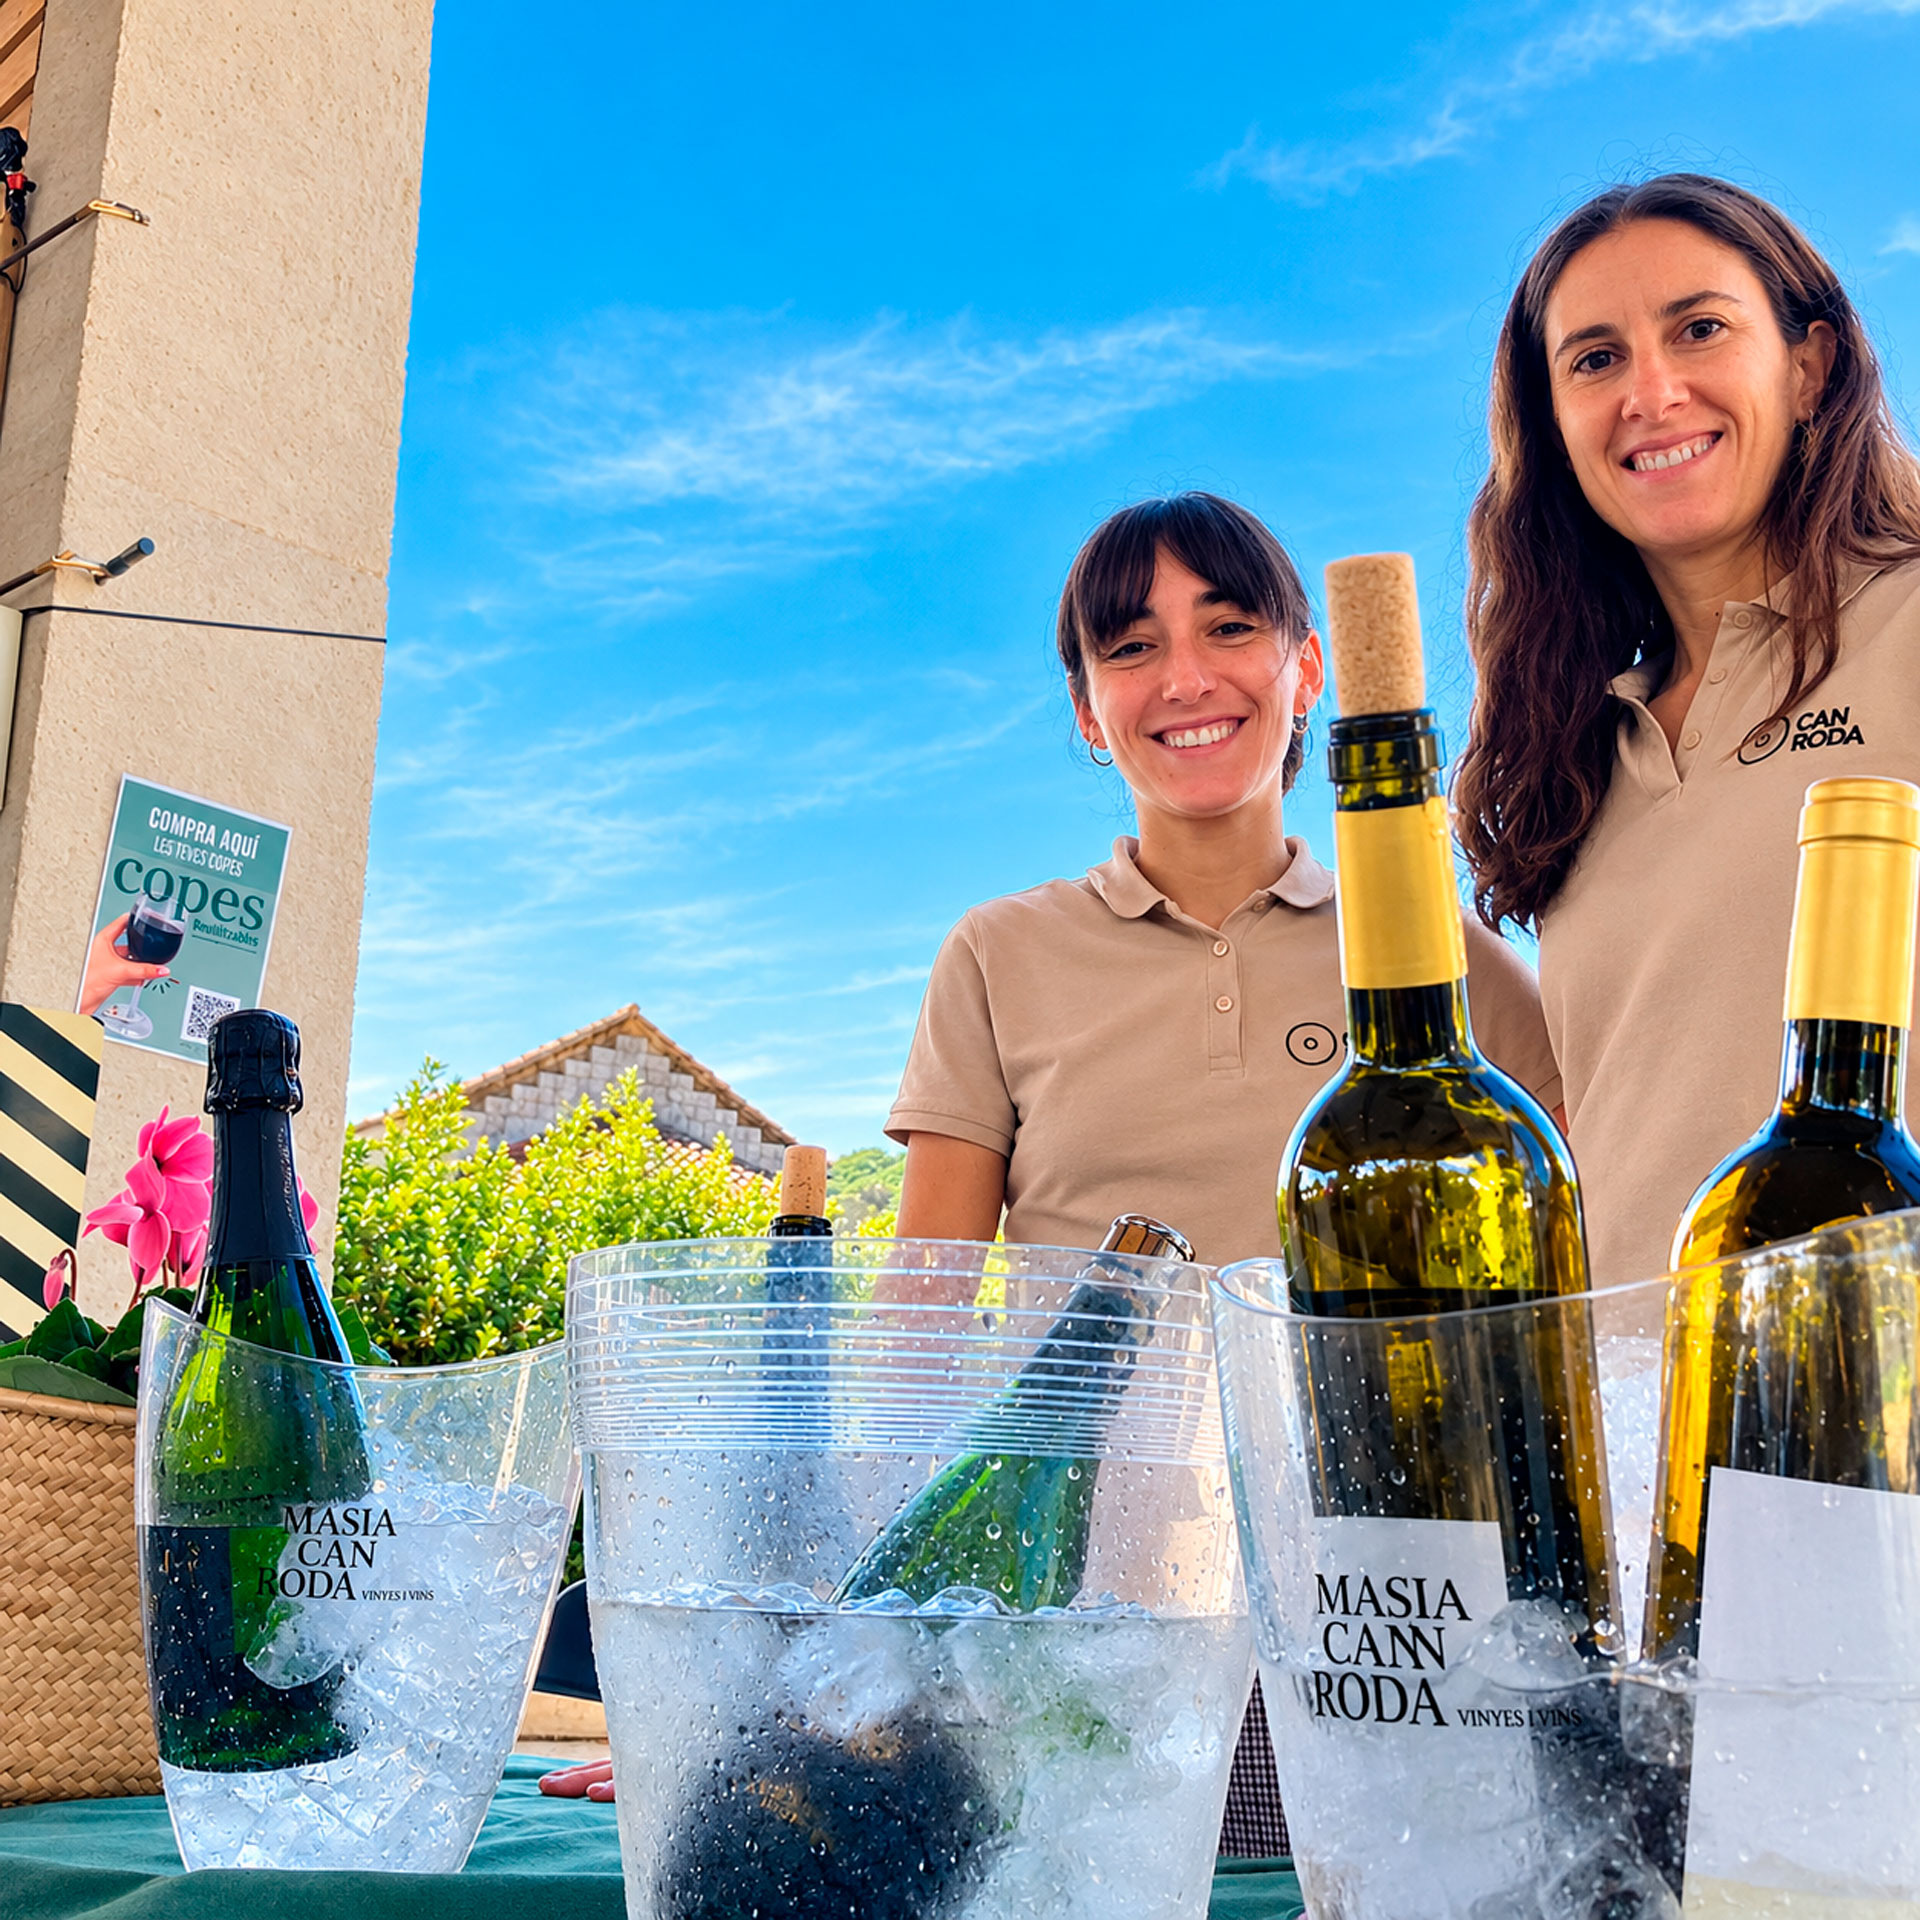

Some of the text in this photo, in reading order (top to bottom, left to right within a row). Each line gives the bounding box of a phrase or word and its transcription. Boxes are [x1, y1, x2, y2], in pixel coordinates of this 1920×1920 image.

[1796, 706, 1850, 731] CAN
[1790, 724, 1865, 752] RODA
[148, 806, 261, 860] COMPRA AQUÍ
[153, 835, 175, 857] LES
[208, 852, 244, 877] COPES
[113, 857, 265, 931] copes
[283, 1505, 397, 1537] MASIA
[297, 1538, 377, 1568] CAN
[256, 1566, 356, 1600] RODA
[362, 1589, 401, 1601] VINYES
[408, 1589, 435, 1601] VINS
[1314, 1573, 1472, 1621] MASIA
[1311, 1669, 1449, 1727] RODA
[1456, 1708, 1525, 1728] VINYES
[1536, 1708, 1583, 1728] VINS
